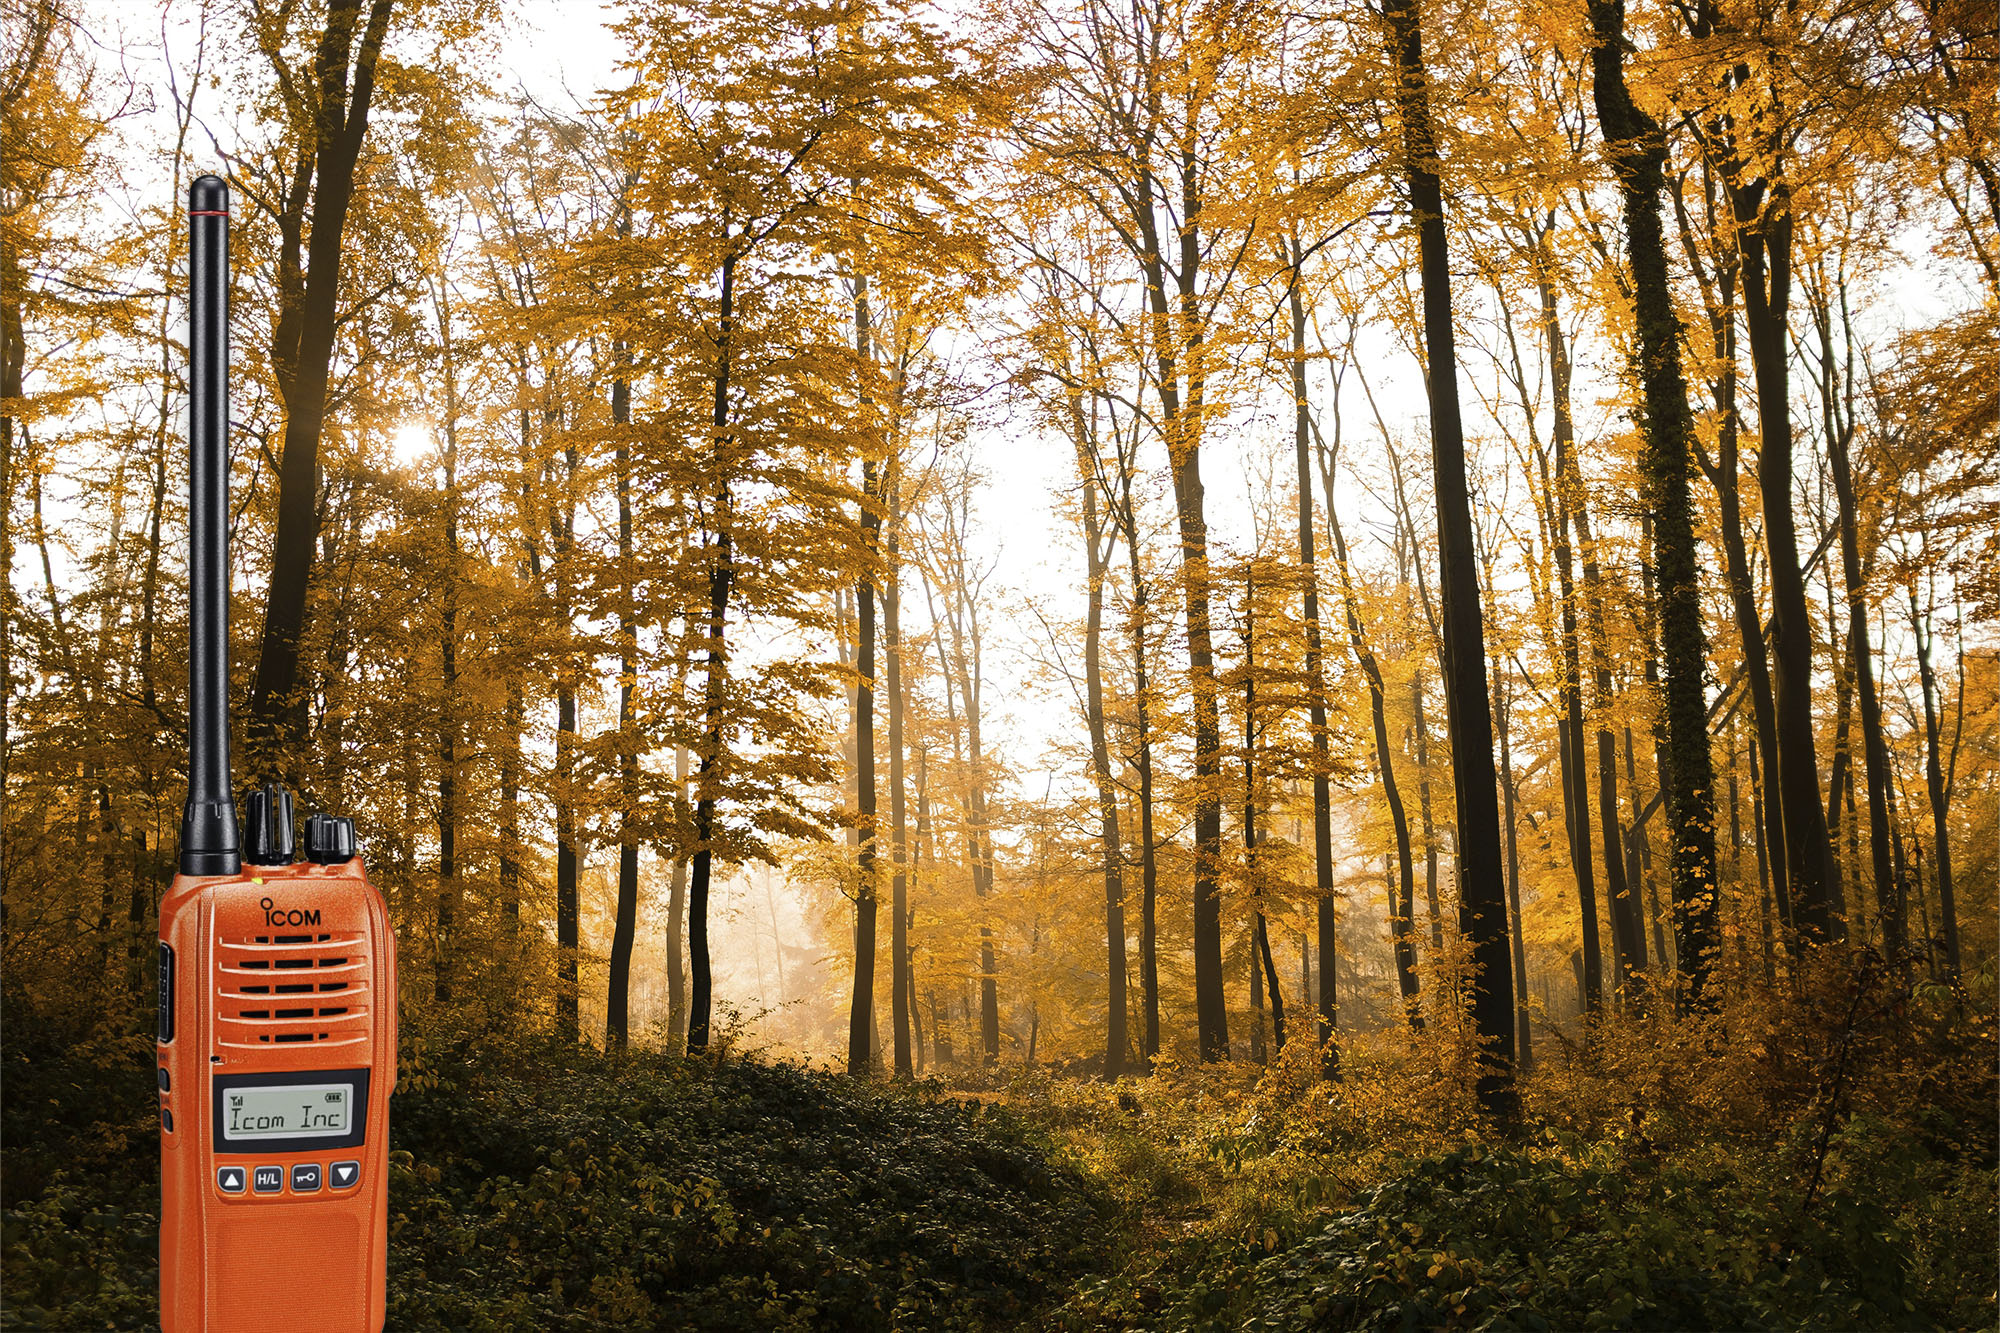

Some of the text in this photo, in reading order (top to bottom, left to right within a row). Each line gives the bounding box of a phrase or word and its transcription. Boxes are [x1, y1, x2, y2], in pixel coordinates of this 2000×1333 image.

[229, 1105, 341, 1131] Icom Inc
[257, 1173, 279, 1186] H/L
